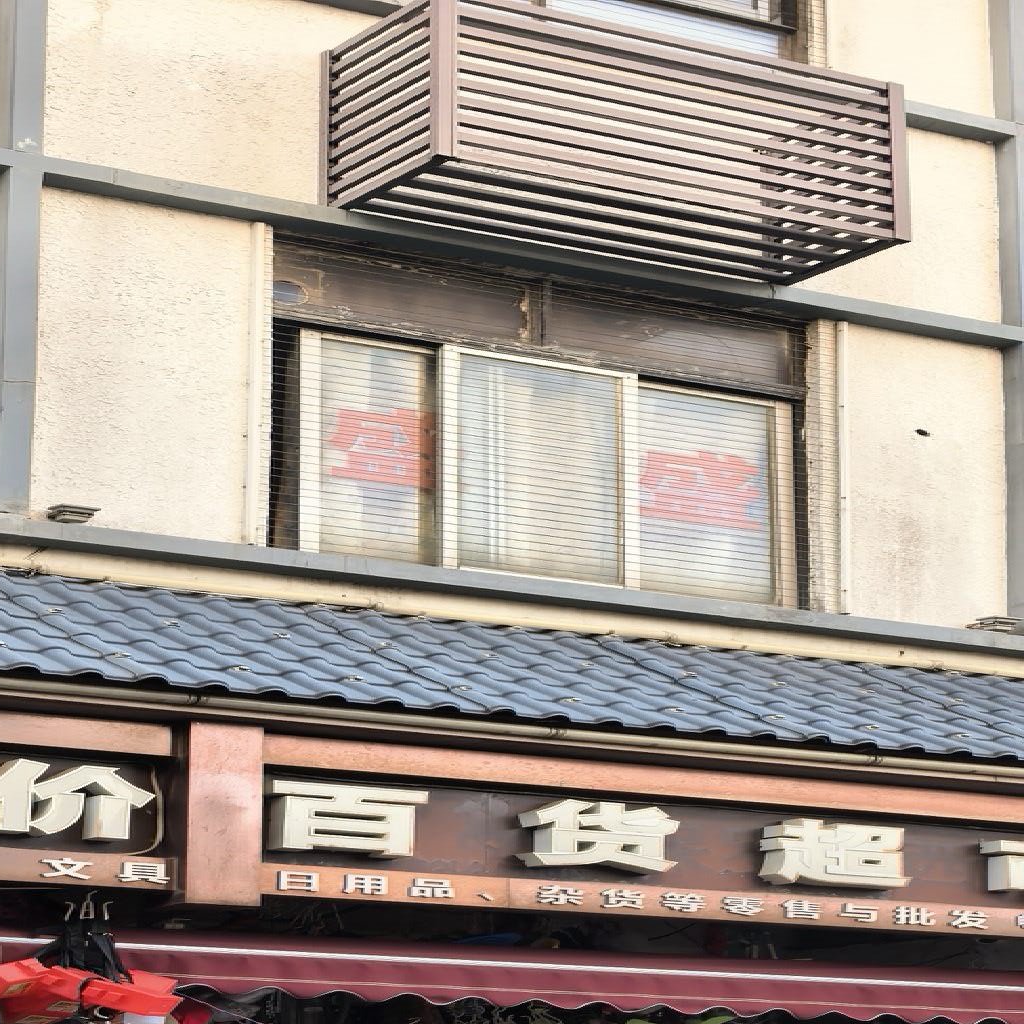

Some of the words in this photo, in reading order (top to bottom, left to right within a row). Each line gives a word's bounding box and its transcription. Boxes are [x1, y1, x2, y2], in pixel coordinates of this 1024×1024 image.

[276, 870, 1024, 930] 日用品、杂货等零售与批发
